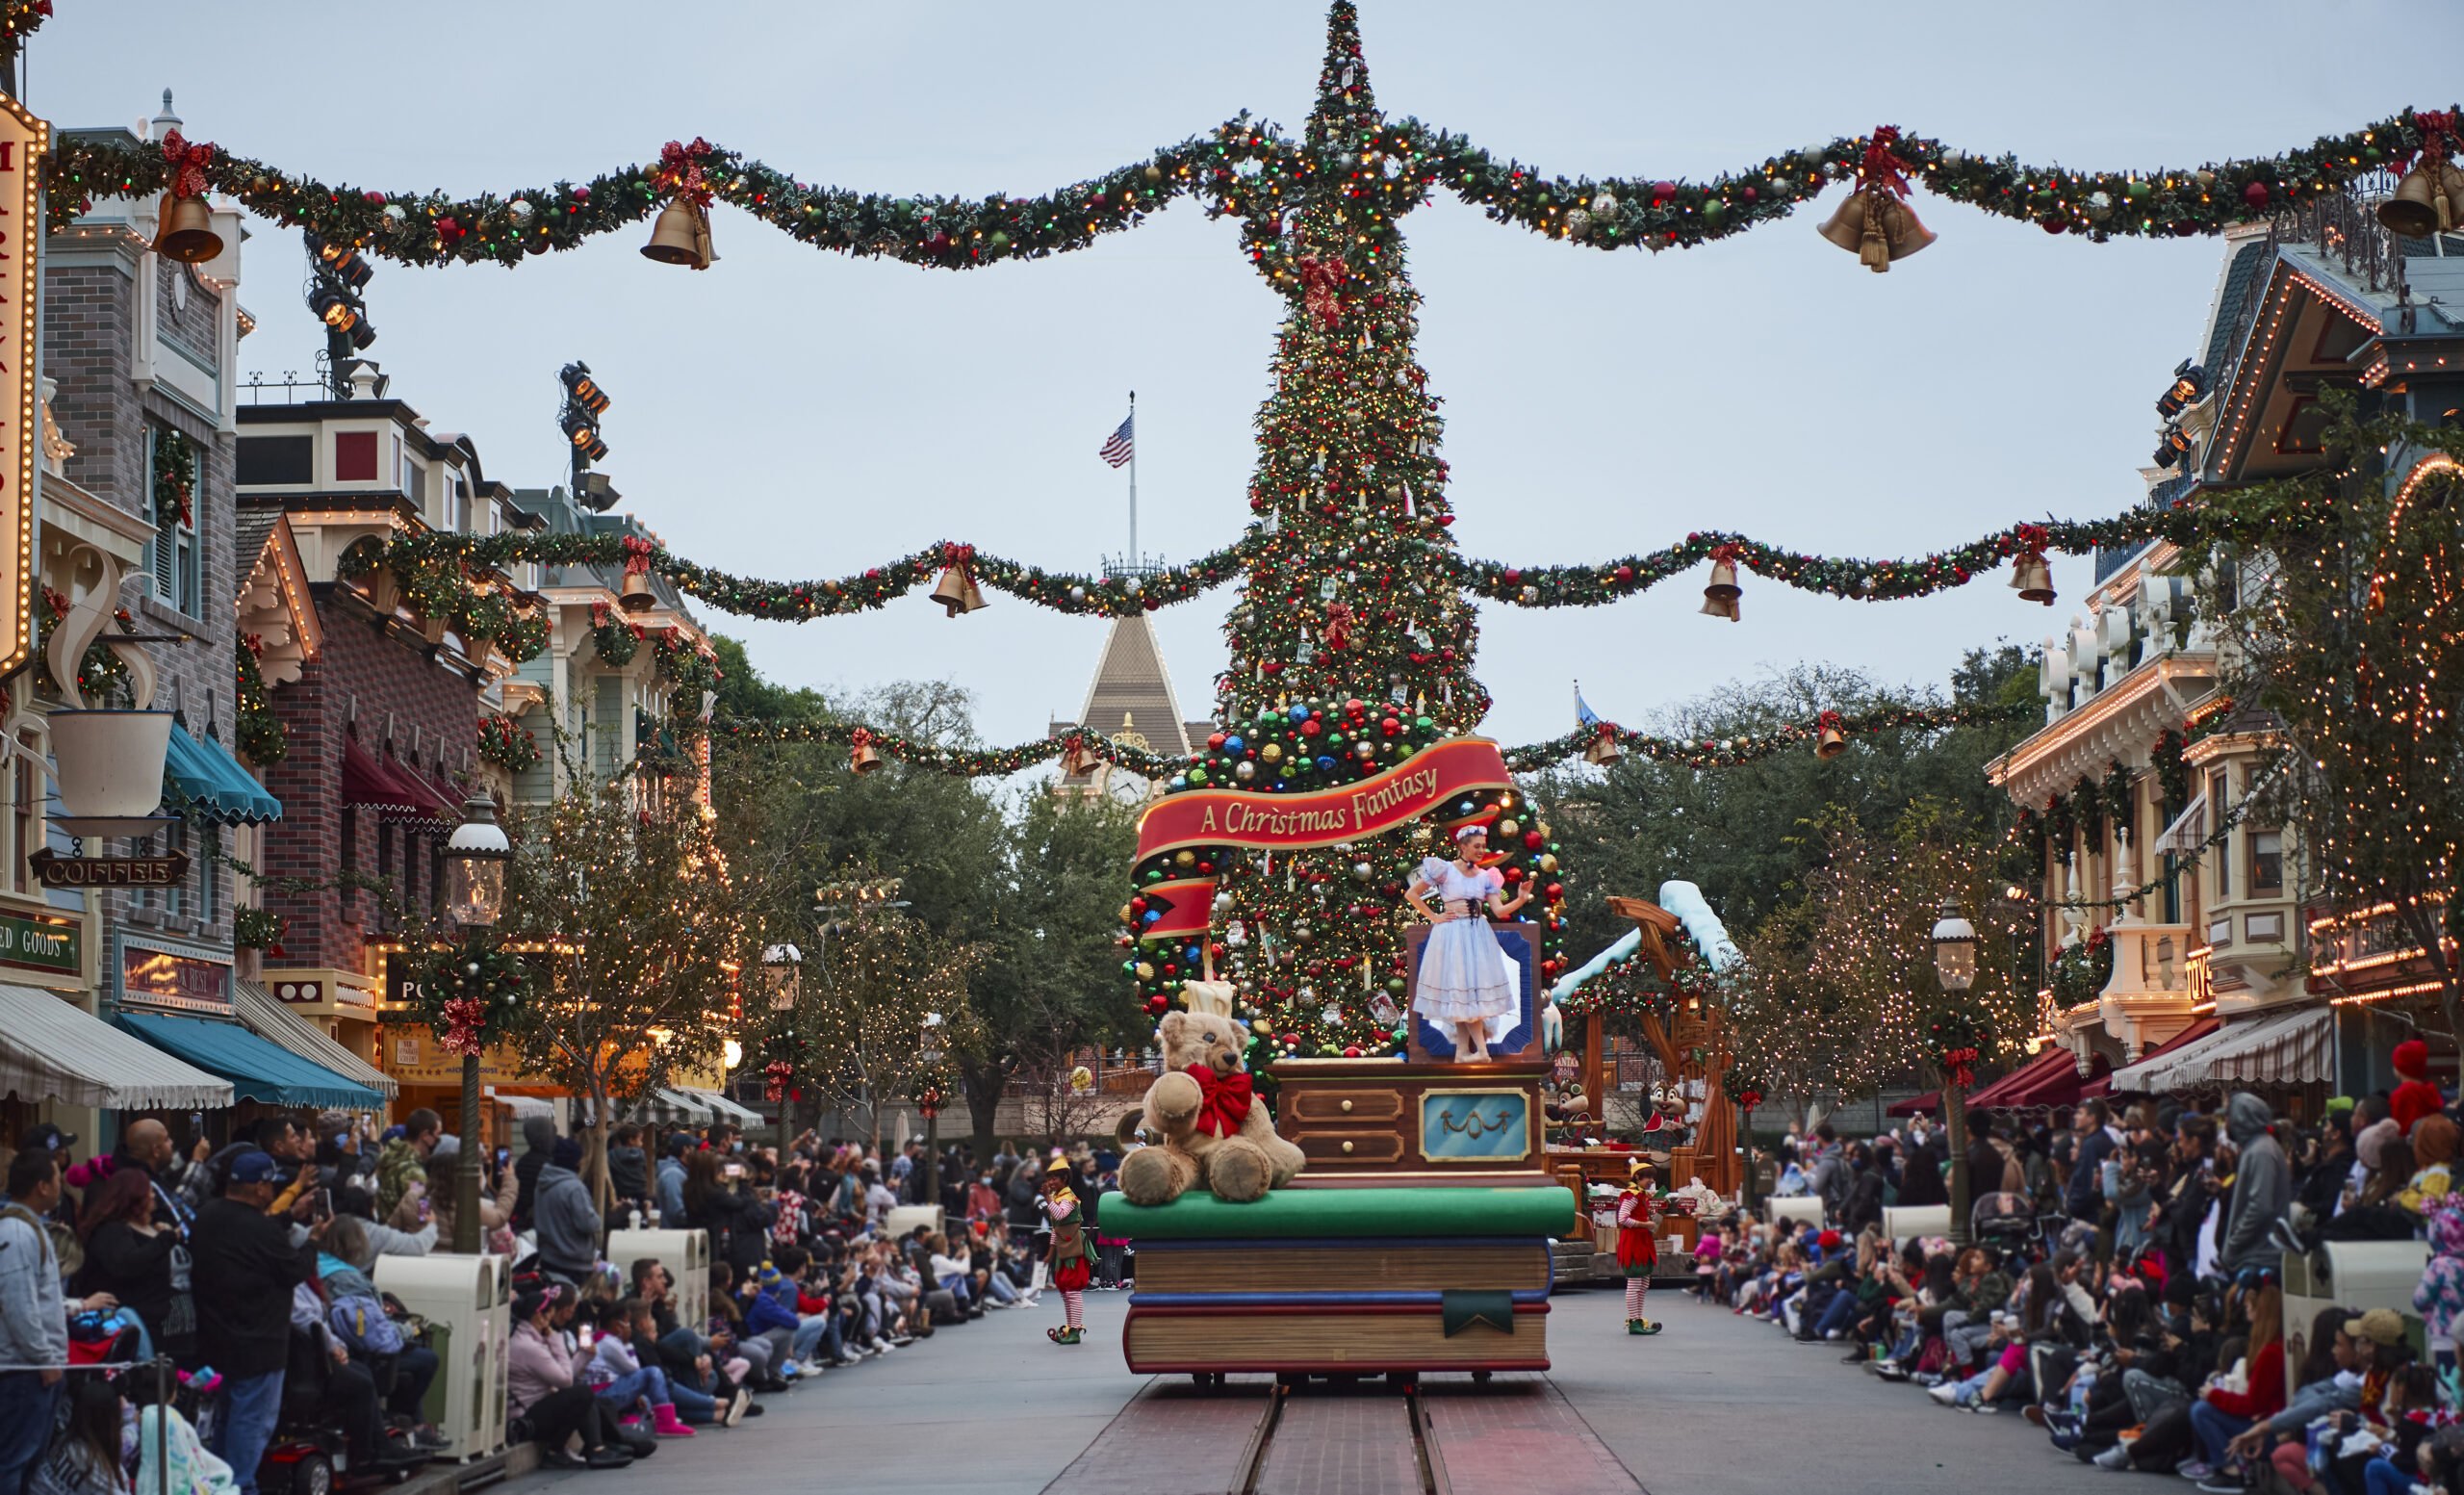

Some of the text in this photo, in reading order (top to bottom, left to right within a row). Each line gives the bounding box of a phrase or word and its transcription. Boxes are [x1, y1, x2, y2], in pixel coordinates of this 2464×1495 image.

[1200, 767, 1437, 835] A Christmas Fantasy
[46, 862, 172, 884] COFFEE
[22, 930, 61, 957] GOODS
